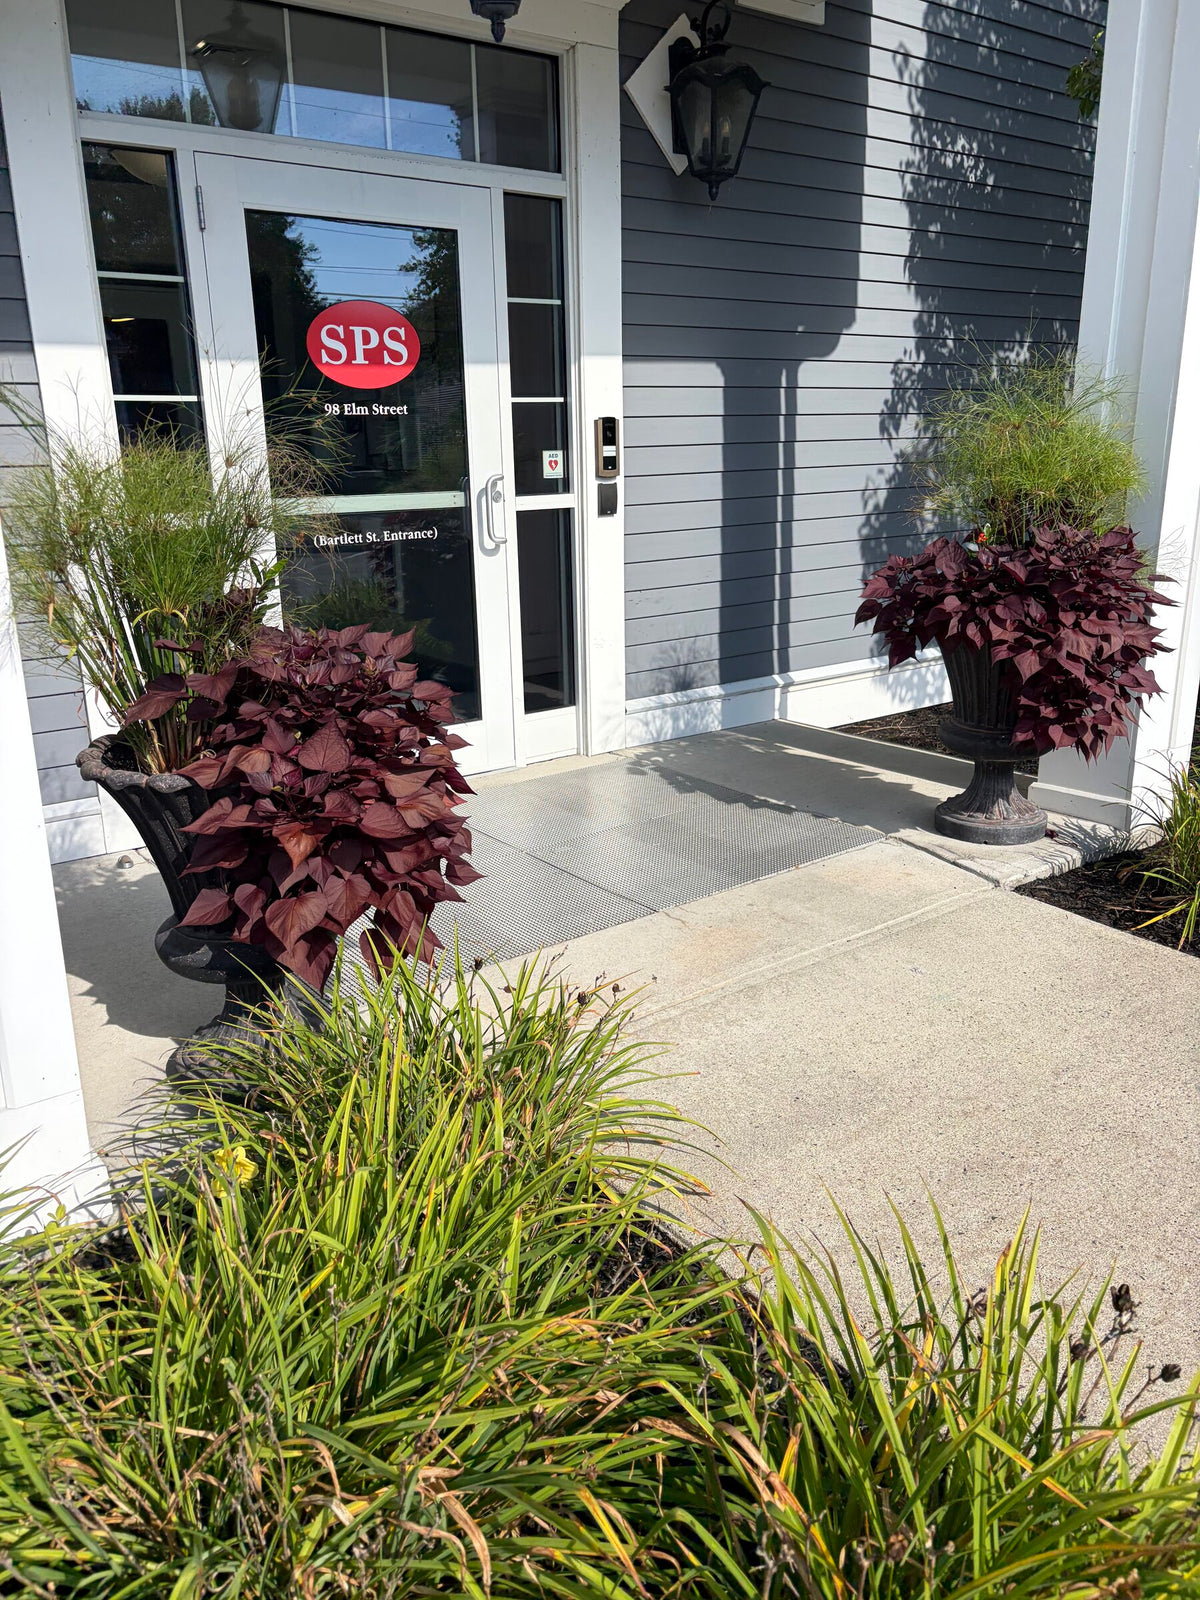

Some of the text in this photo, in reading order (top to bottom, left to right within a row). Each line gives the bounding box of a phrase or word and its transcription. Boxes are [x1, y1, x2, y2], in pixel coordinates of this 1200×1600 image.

[320, 324, 408, 366] SPS
[324, 402, 408, 416] 98 Elm Street
[313, 526, 438, 548] (Bartlett St. Entrance)
